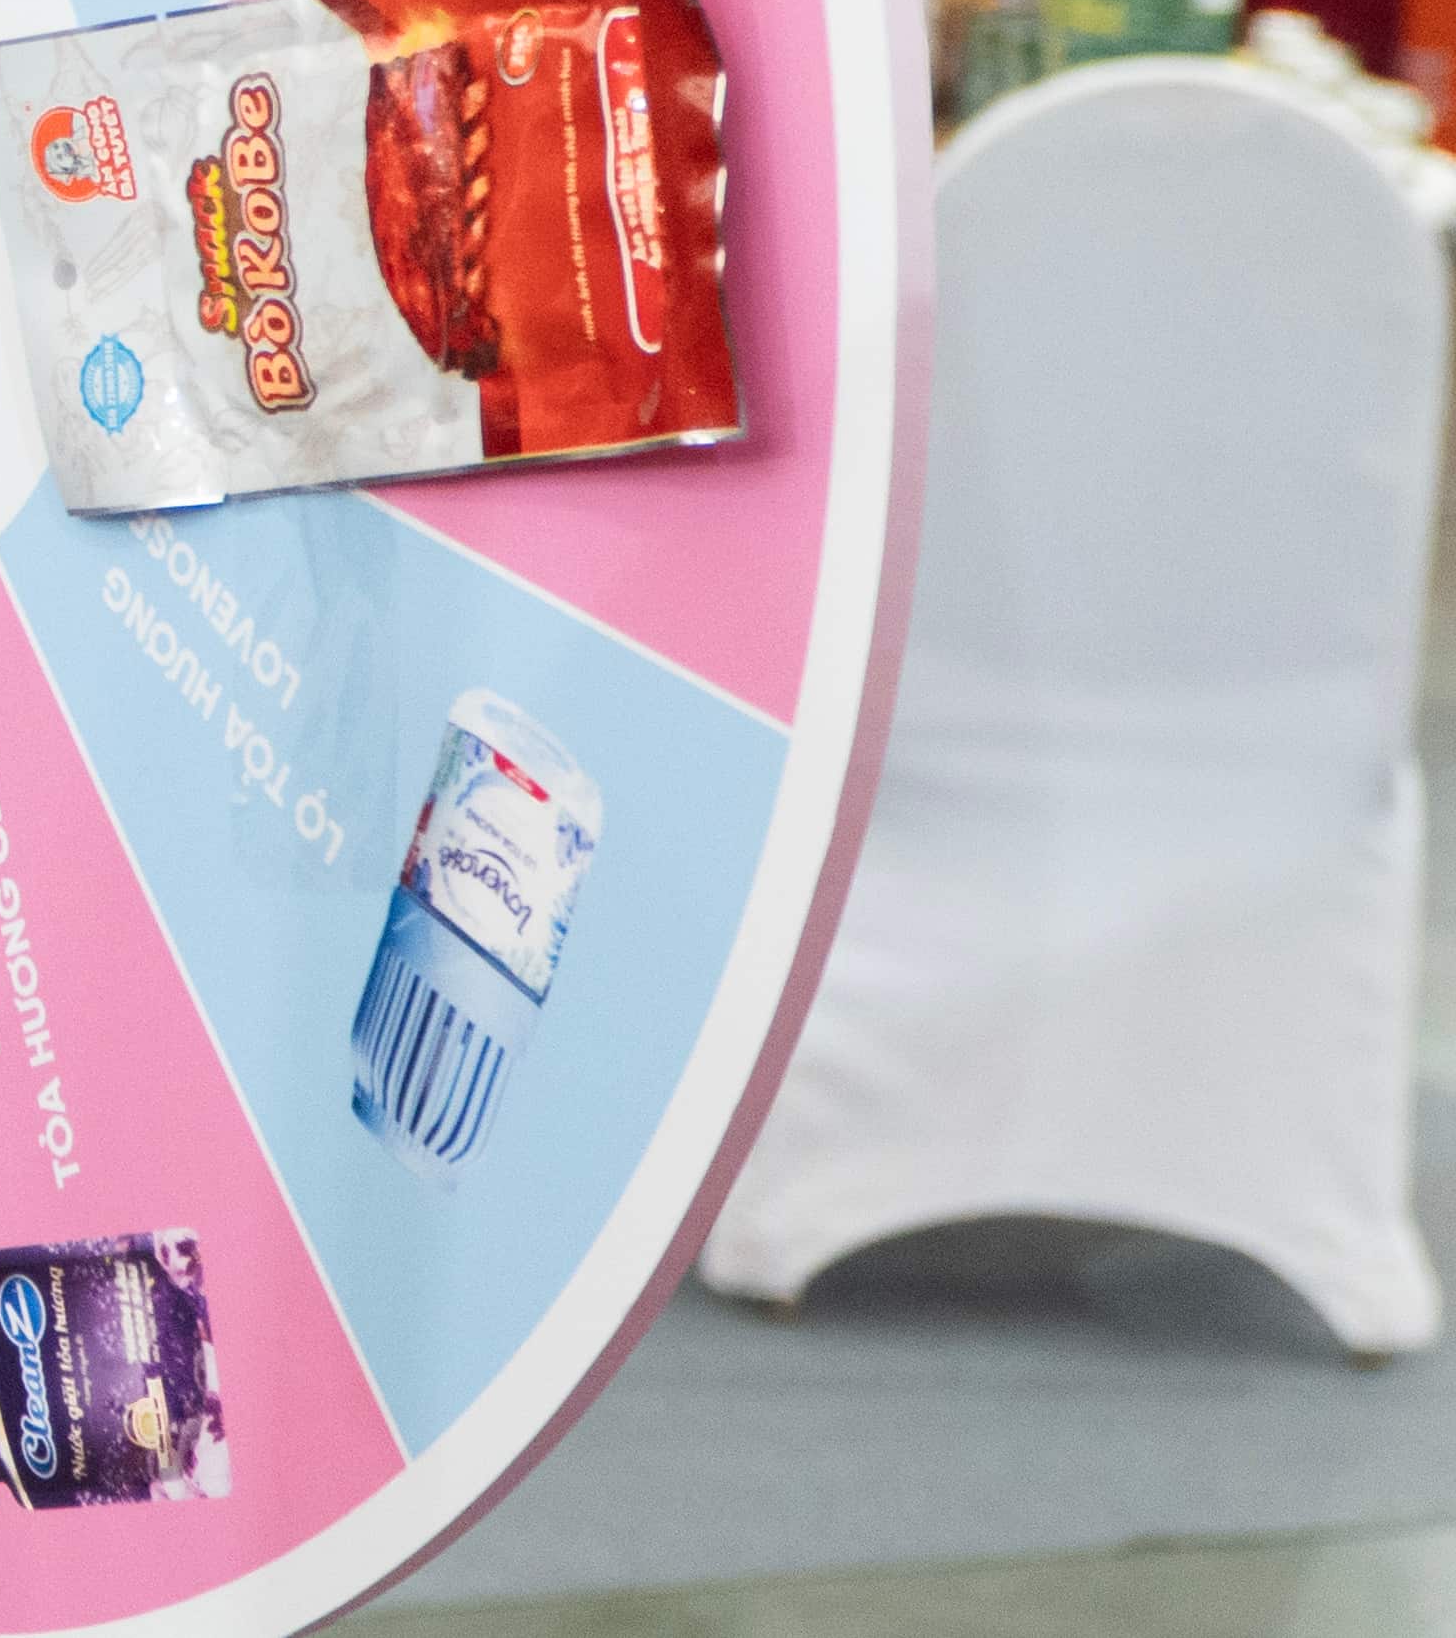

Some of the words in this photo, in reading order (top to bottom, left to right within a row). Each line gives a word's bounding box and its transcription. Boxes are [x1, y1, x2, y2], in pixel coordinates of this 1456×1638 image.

[188, 159, 237, 333] Snack
[101, 566, 225, 722] HƯƠNG
[224, 700, 290, 809] TỎA
[294, 786, 346, 867] LỌ
[36, 1074, 81, 1191] TỎA
